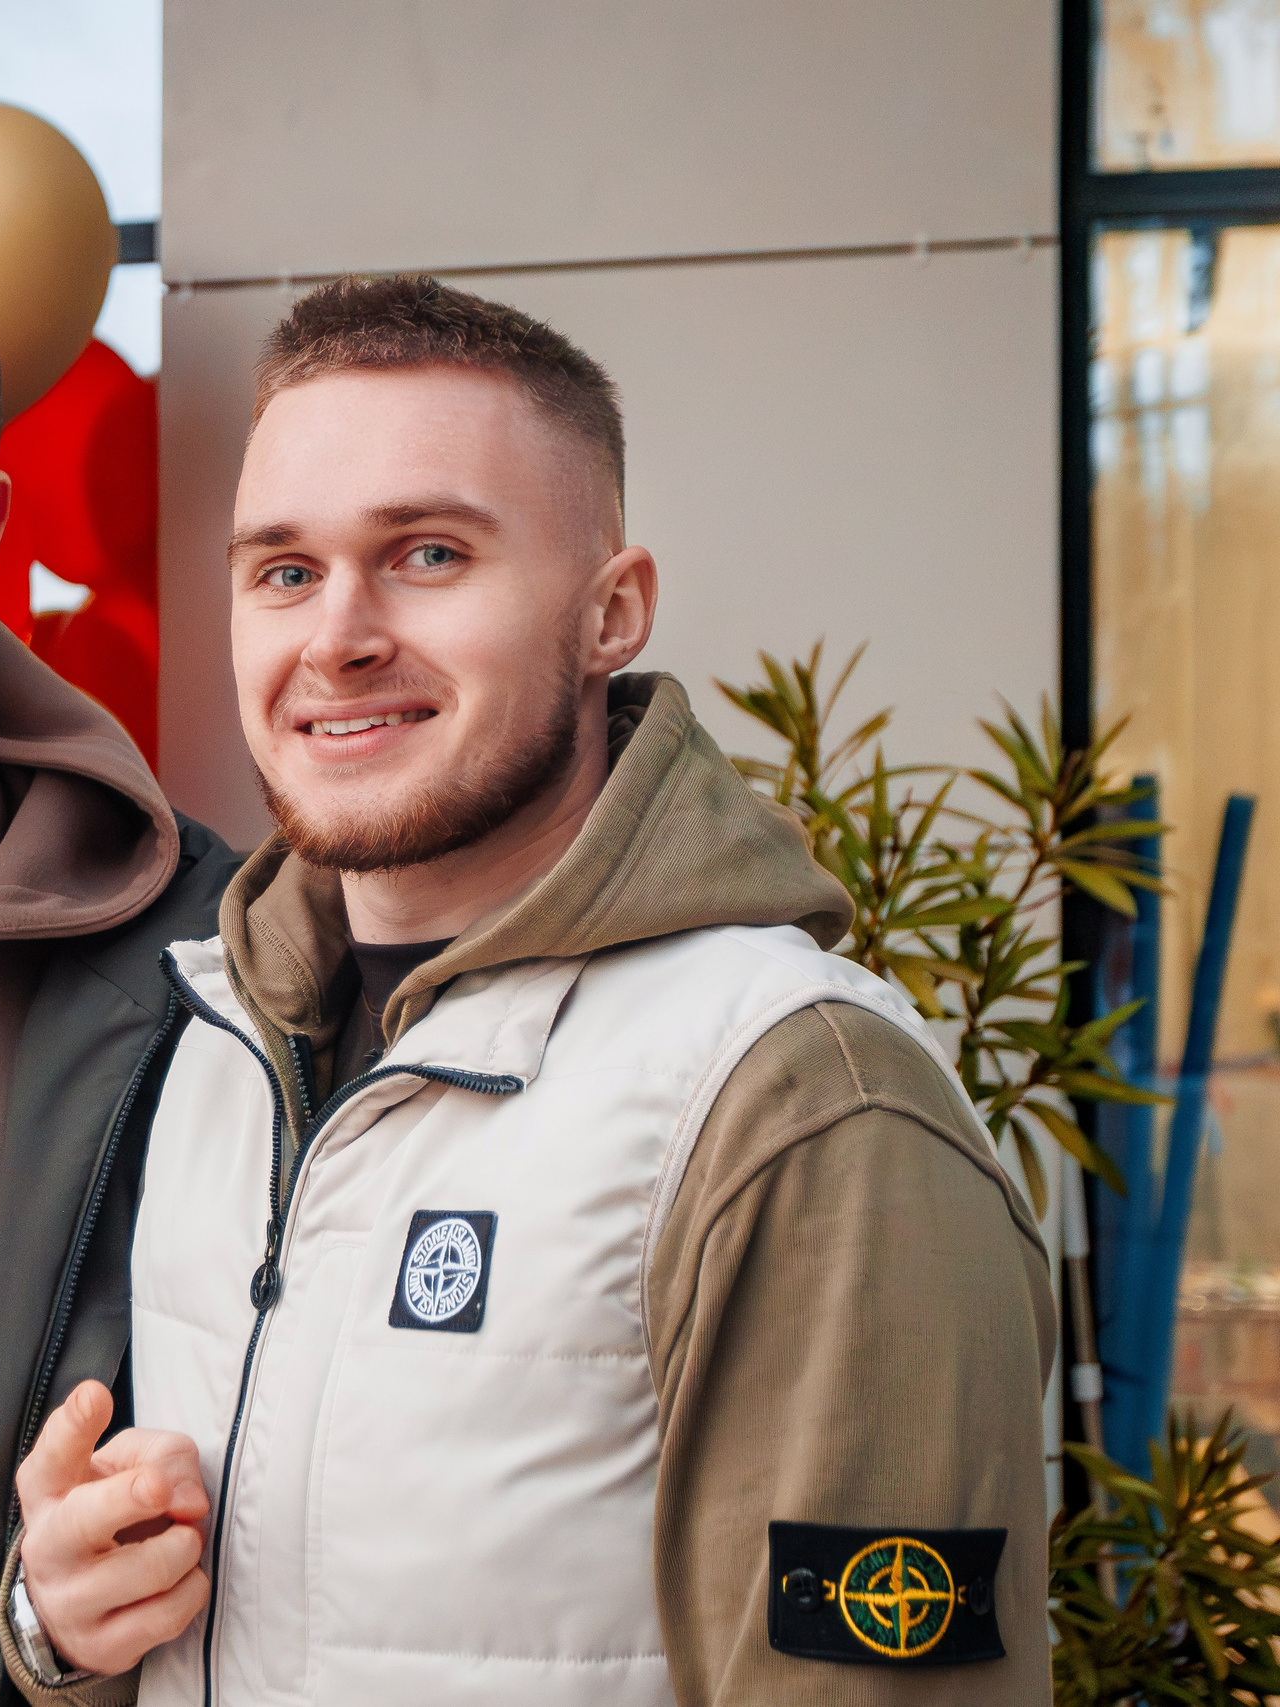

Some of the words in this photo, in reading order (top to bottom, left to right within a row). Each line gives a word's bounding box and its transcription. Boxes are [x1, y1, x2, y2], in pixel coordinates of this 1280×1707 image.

[413, 1225, 449, 1265] STONE
[452, 1225, 477, 1266] ISLAND
[409, 1272, 432, 1314] ISLAND
[438, 1272, 474, 1314] STONE
